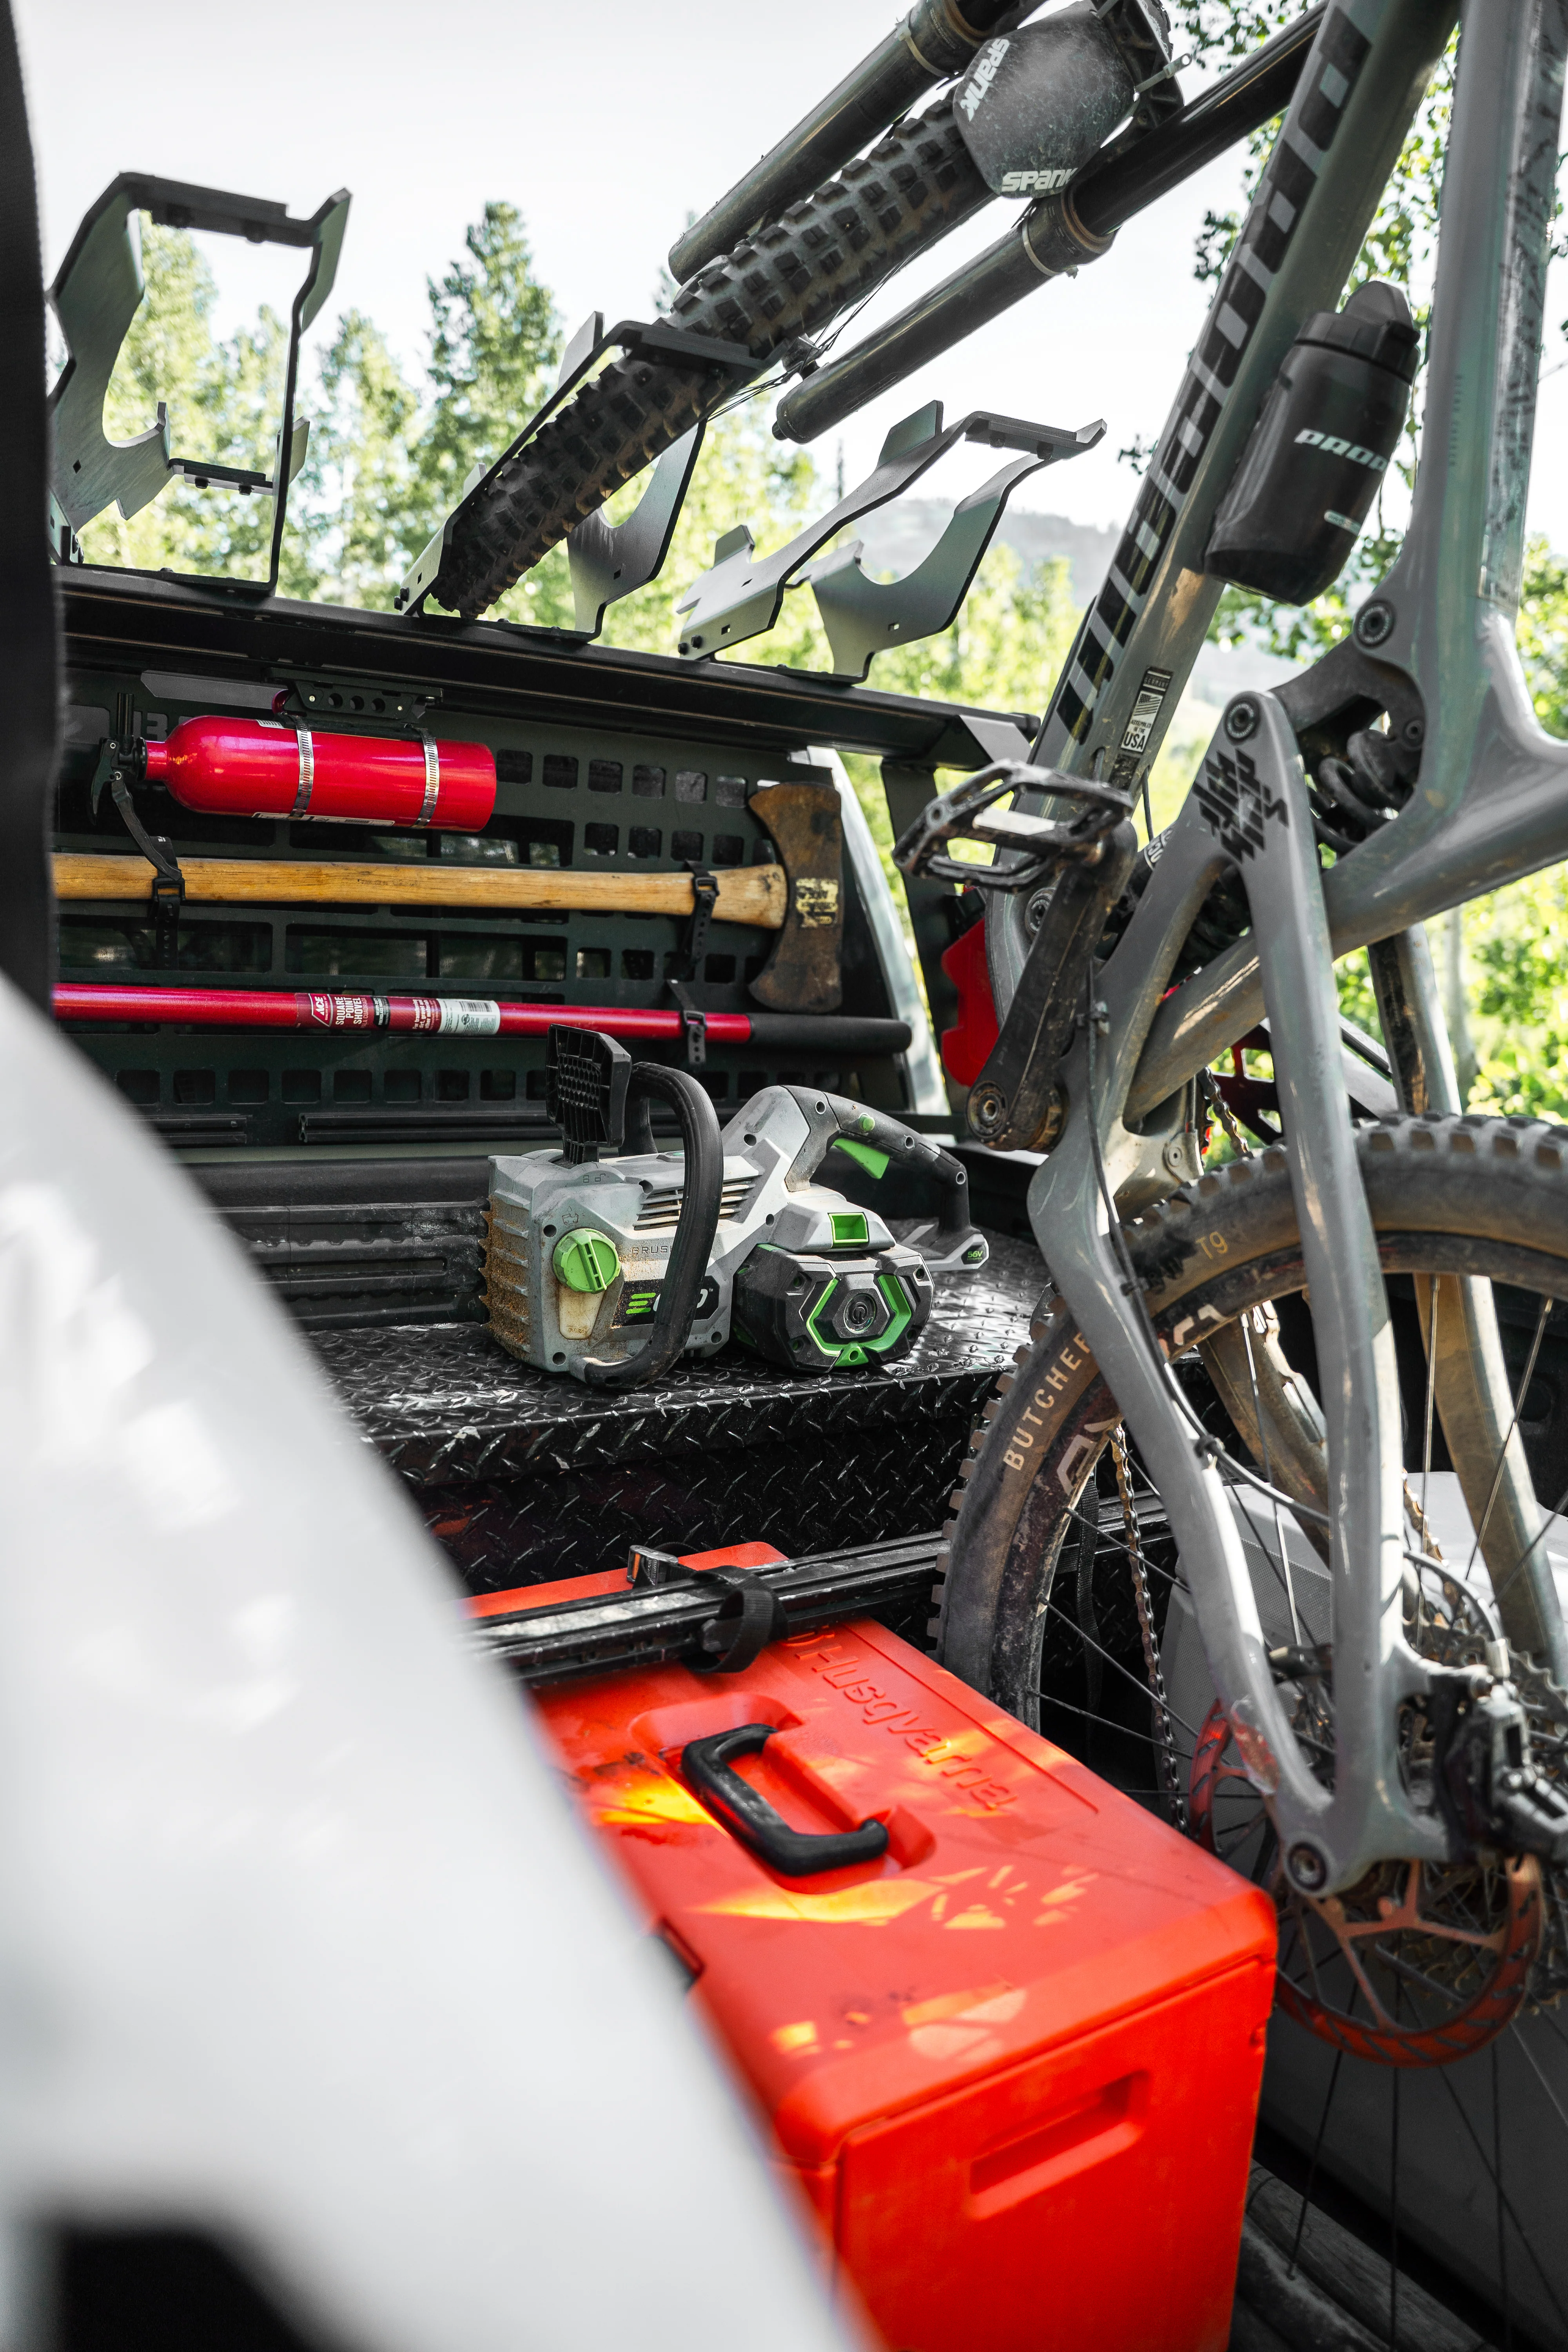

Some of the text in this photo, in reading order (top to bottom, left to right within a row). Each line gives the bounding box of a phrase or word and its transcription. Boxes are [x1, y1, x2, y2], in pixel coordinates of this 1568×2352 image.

[1144, 677, 1169, 688] GERMANY
[1130, 720, 1151, 729] ASSEMBLED
[1123, 732, 1145, 750] USA
[314, 996, 325, 1016] ACE
[335, 996, 345, 1025] SQUARE
[345, 997, 354, 1018] POINT
[353, 997, 363, 1024] SHOVEL
[631, 1245, 672, 1254] BRUS
[795, 1645, 1018, 1810] Husqvarna
